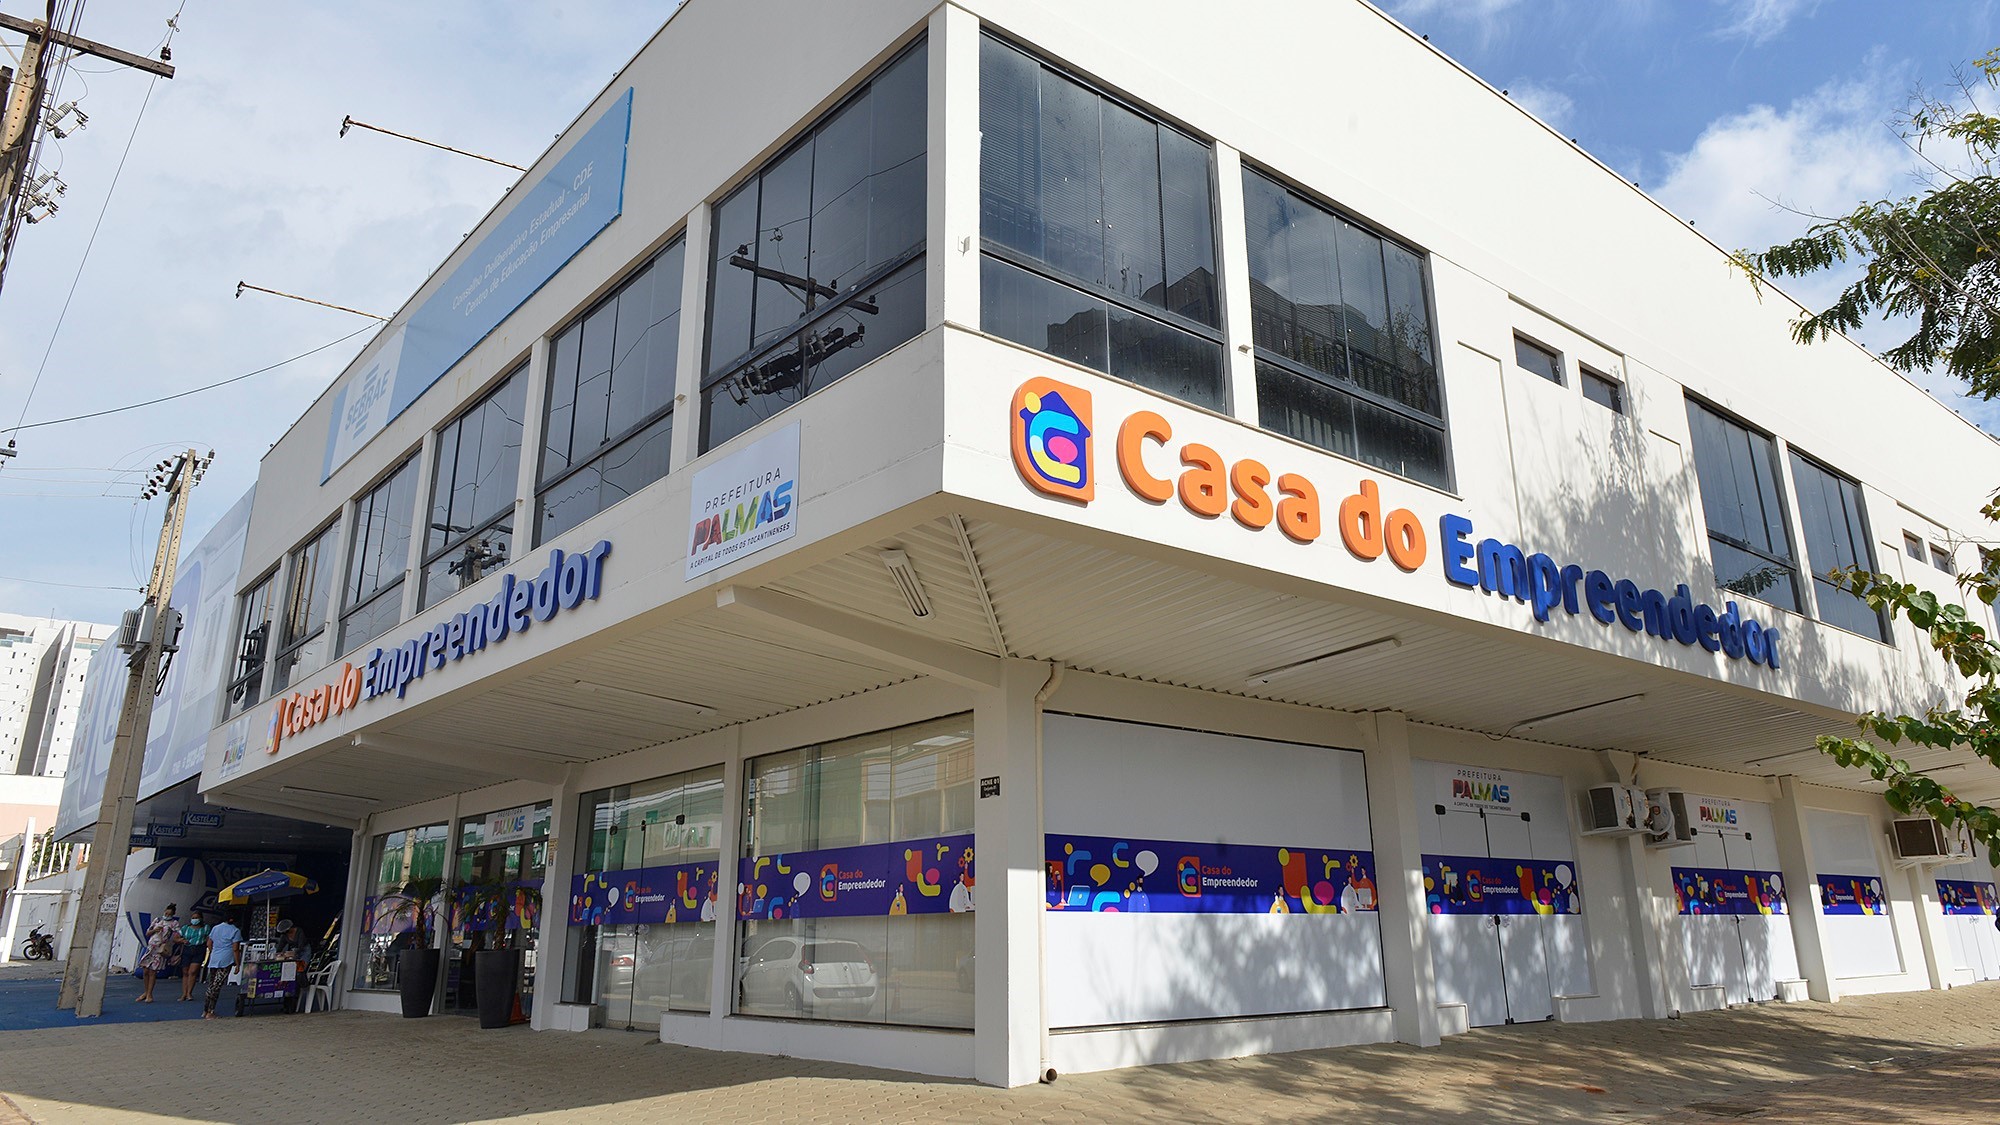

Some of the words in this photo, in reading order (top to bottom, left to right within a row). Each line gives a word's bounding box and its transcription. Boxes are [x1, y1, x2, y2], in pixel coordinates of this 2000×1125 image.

[452, 274, 483, 310] Conselho
[484, 230, 528, 279] Deliberativo
[530, 189, 565, 233] Estadual
[573, 161, 593, 191] CDE
[465, 288, 488, 316] Centro
[489, 277, 499, 293] de
[500, 241, 538, 284] Educação
[540, 186, 591, 246] Empresarial
[345, 369, 390, 431] SEBRAE
[705, 468, 781, 513] PREFEITURA
[691, 480, 793, 556] PALMAS
[690, 562, 694, 570] A
[694, 554, 714, 568] CAPITAL
[715, 550, 721, 559] DE
[722, 544, 738, 555] TODOS
[739, 540, 746, 549] OS
[747, 522, 790, 544] TOCANTINENSES
[1116, 411, 1321, 545] Casa
[1338, 478, 1427, 572] do
[1440, 512, 1780, 671] Empreendedor
[281, 684, 331, 738] Casa
[331, 662, 362, 716] do
[363, 539, 612, 699] Empreendedor
[1452, 778, 1510, 804] PALMAS
[1457, 769, 1502, 781] PREFEITURA
[185, 813, 219, 825] KASTELAR
[838, 871, 854, 880] Casa
[854, 869, 864, 878] do
[838, 878, 886, 892] Empreendedor
[1202, 865, 1221, 875] Casa
[1221, 865, 1232, 875] do
[1202, 876, 1258, 889] Empreendedor
[1482, 885, 1519, 895] Empreendedor
